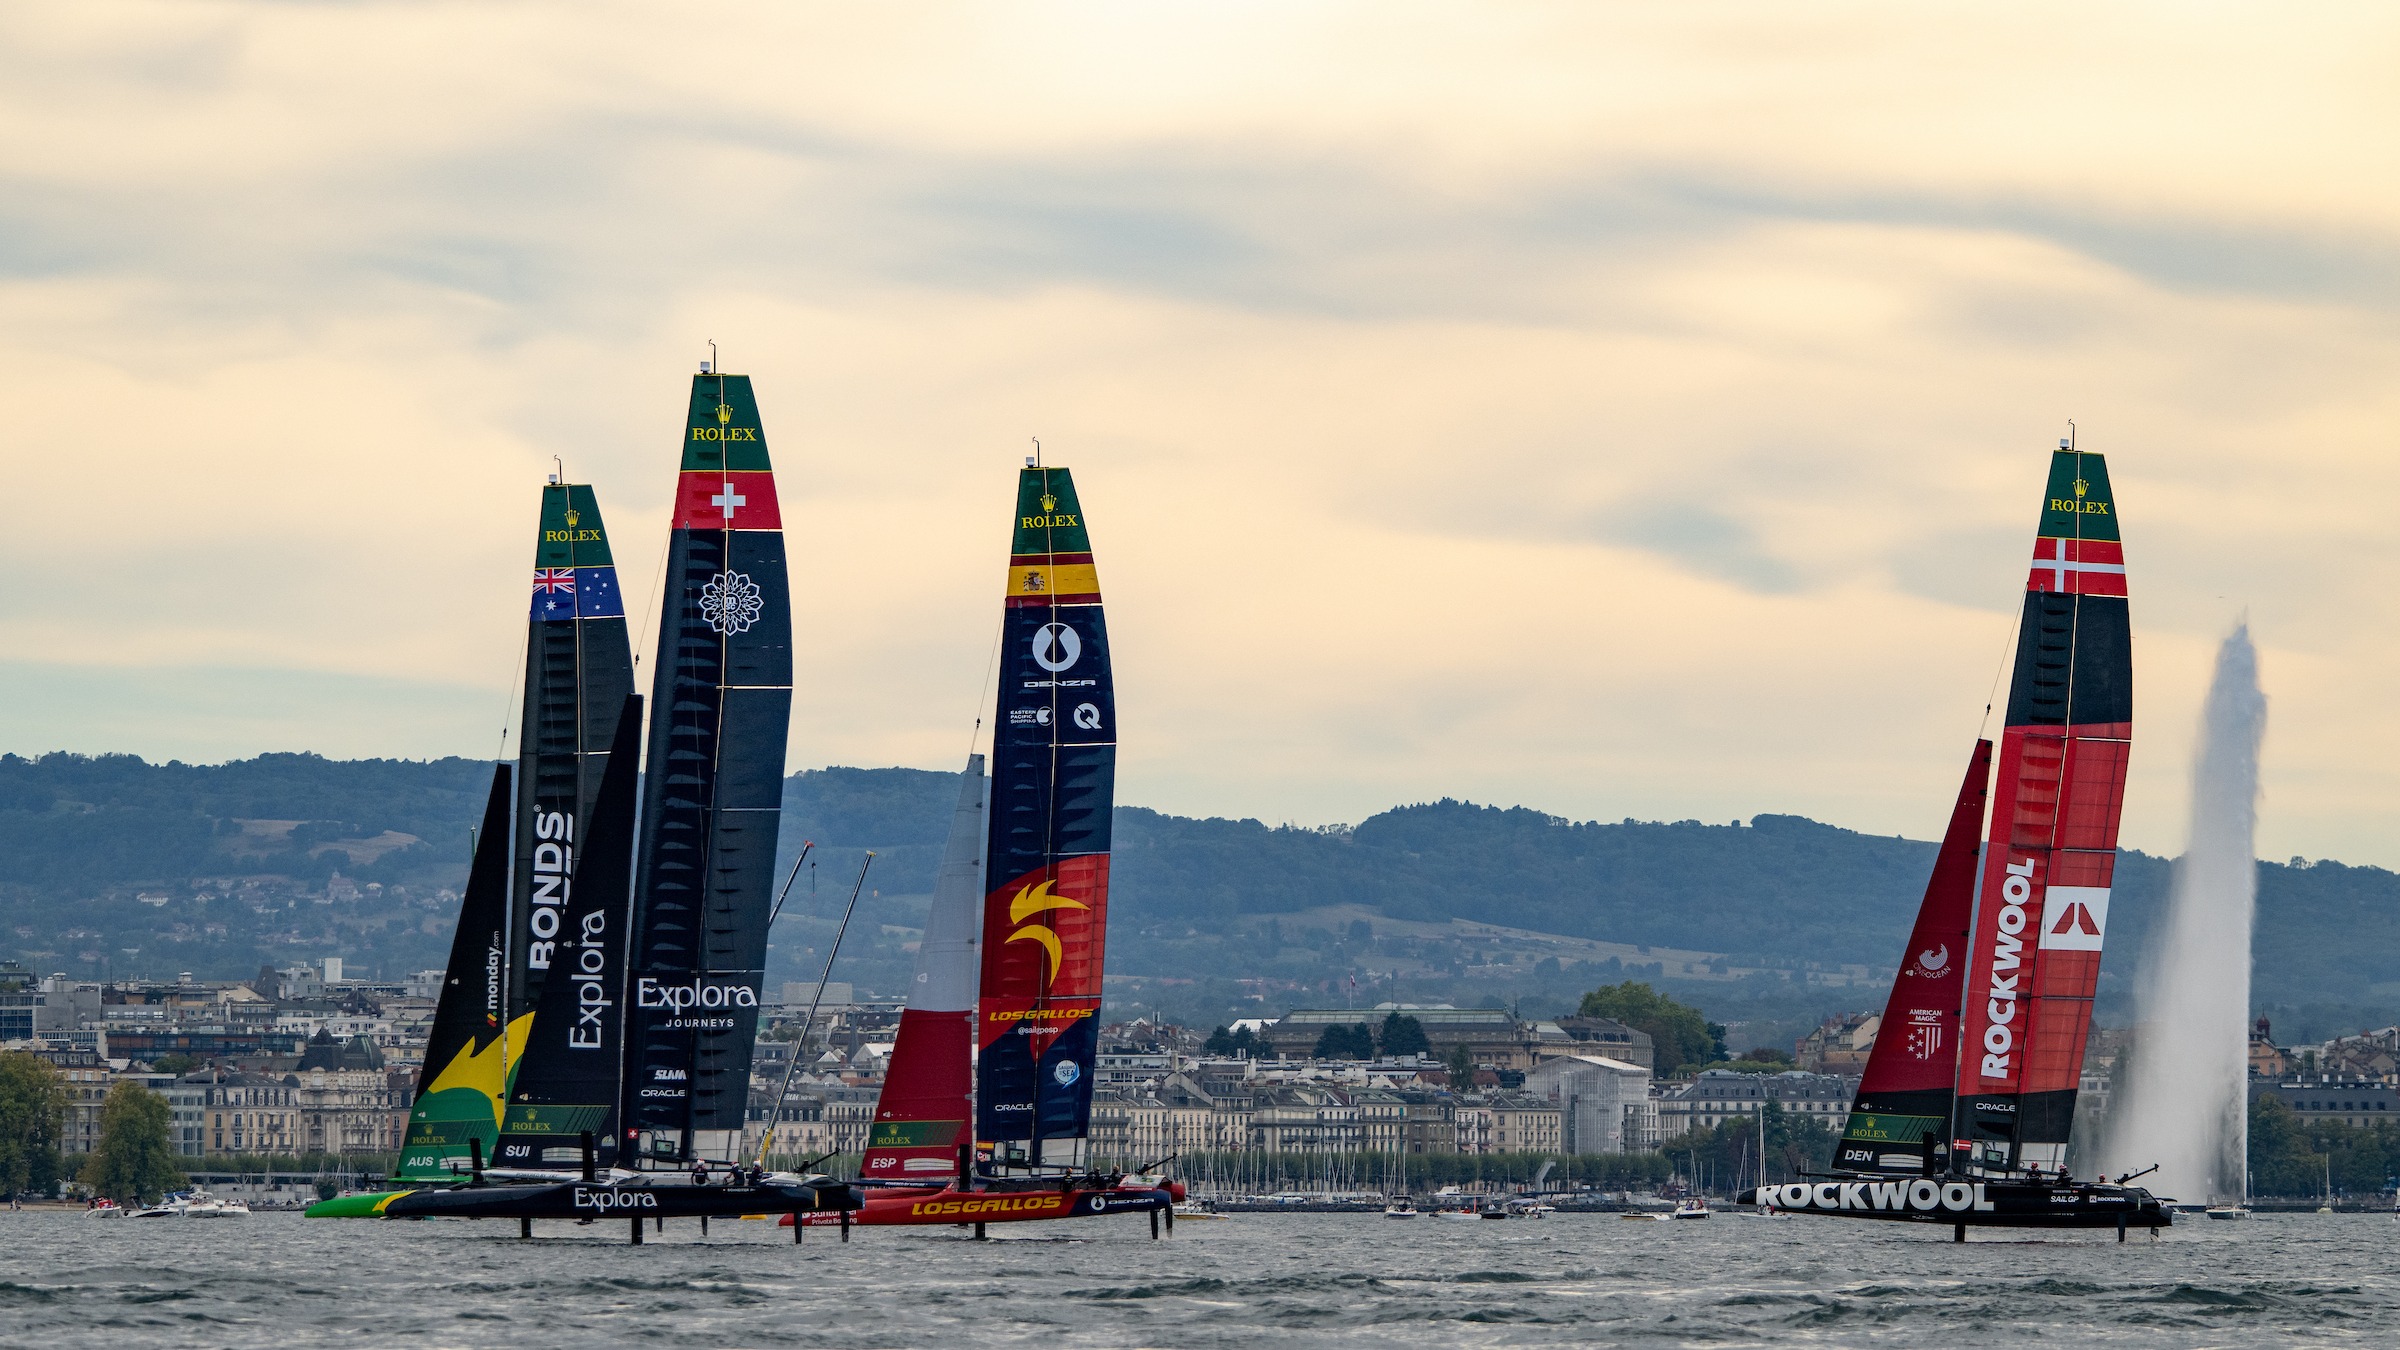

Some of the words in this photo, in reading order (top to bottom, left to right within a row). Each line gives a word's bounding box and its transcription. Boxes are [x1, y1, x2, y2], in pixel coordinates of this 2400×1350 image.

[692, 427, 756, 442] ROLEX
[2051, 498, 2109, 515] ROLEX
[1021, 514, 1078, 529] ROLEX
[545, 529, 601, 542] ROLEX
[1024, 680, 1096, 688] DENZA
[486, 930, 502, 1010] monday.com
[1981, 858, 2035, 1079] ROCKWOOL
[569, 908, 612, 1049] Explora
[638, 977, 758, 1016] Explora
[990, 1008, 1094, 1021] LOSGALLOS
[1909, 1009, 1942, 1017] AMERICAN
[665, 1019, 735, 1028] JOURNEYS
[654, 1070, 687, 1080] SLAM
[1062, 1069, 1075, 1077] SEA
[641, 1089, 686, 1097] ORACLE
[995, 1103, 1034, 1112] ORACLE
[1975, 1102, 2016, 1112] ORACLE
[512, 1122, 551, 1131] ROLEX
[1852, 1128, 1888, 1138] ROLEX
[412, 1135, 446, 1144] ROLEX
[877, 1136, 911, 1145] ROLEX
[505, 1145, 531, 1157] SUI
[1844, 1150, 1873, 1162] DEN
[407, 1156, 434, 1167] AUS
[871, 1157, 897, 1169] ESP
[574, 1187, 658, 1213] Explora
[1756, 1179, 1994, 1212] ROCKWOOL
[912, 1196, 1063, 1215] LOSGALLOS
